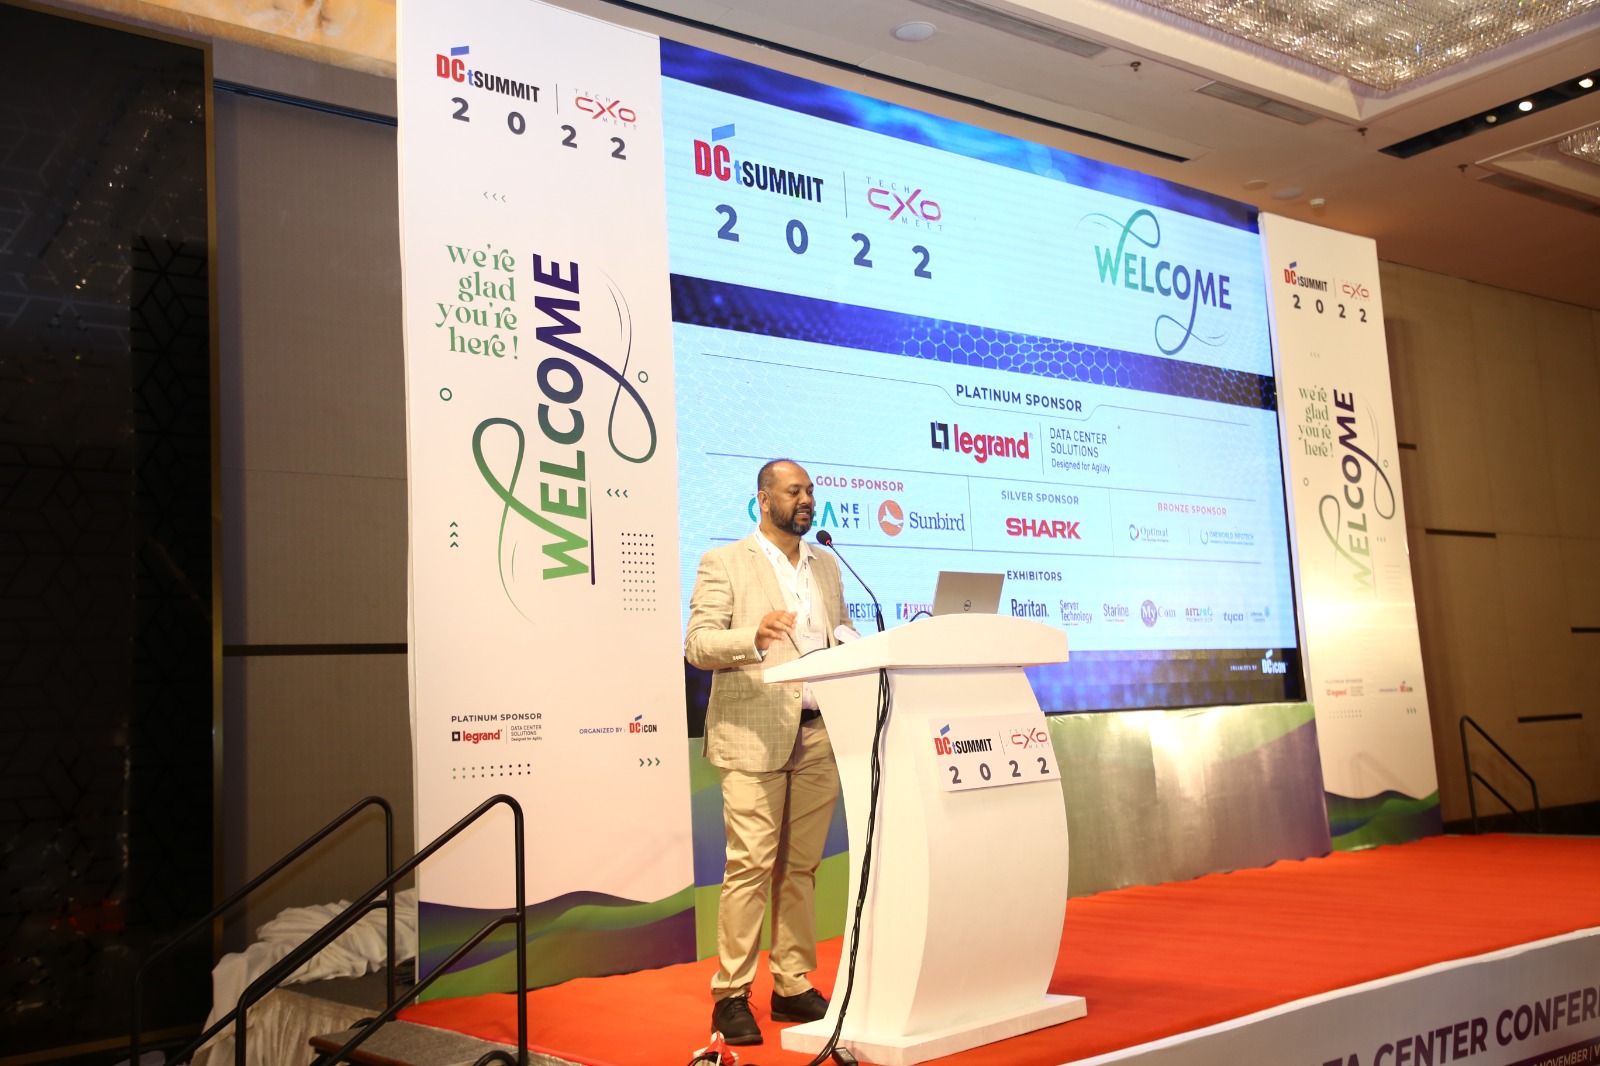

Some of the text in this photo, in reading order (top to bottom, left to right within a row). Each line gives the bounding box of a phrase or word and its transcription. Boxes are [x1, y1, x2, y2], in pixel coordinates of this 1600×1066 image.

[445, 244, 516, 273] we're
[458, 271, 516, 302] glad
[435, 302, 518, 330] you're
[956, 384, 1083, 412] PLATINUM SPONSOR
[1298, 385, 1328, 403] we're
[1305, 403, 1330, 423] glad
[1050, 427, 1108, 445] DATA CENTER
[1298, 422, 1332, 441] you're
[953, 423, 1030, 464] legrand
[1050, 441, 1099, 458] SOLUTIONS
[1051, 458, 1110, 475] Designed for Agility
[816, 475, 904, 492] GOLD SPONSOR
[1001, 490, 1079, 505] SILVER SPONSOR
[1157, 502, 1227, 516] BRONZE SPONSOR
[909, 511, 966, 531] Sunbird
[1005, 517, 1081, 540] SHARK
[1140, 527, 1169, 539] Optimal
[1006, 570, 1063, 582] EXHIBITORS
[1059, 600, 1079, 610] Server
[1060, 609, 1093, 624] Technology
[1223, 611, 1244, 624] tyco
[451, 713, 542, 723] PLATINUM SPONSOR
[462, 729, 501, 744] legrand
[1373, 984, 1600, 1066] CENTER CONFER
